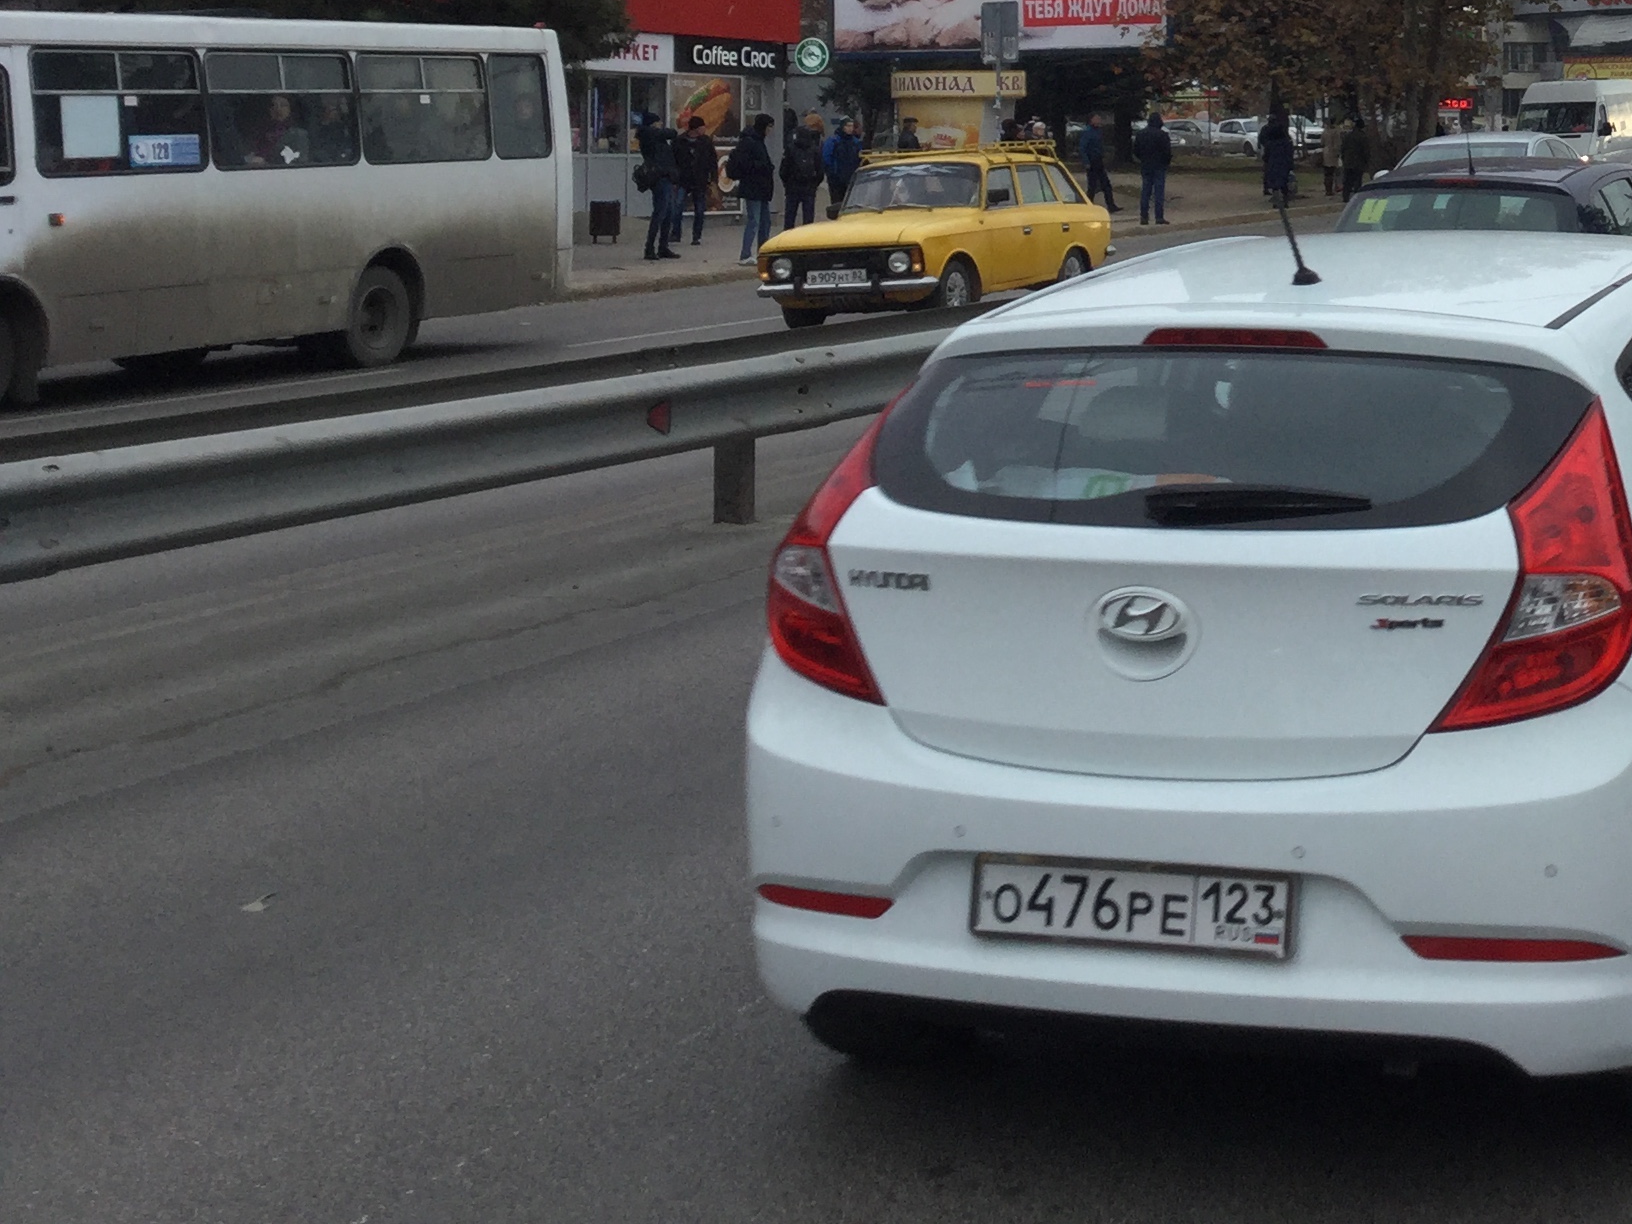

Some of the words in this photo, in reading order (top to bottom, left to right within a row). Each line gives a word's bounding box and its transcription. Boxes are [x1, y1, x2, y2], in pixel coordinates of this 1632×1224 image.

[1025, 0, 1064, 18] ТЕБЯ
[693, 44, 738, 66] Coffee
[1355, 594, 1484, 607] SOLARIS
[1201, 880, 1275, 926] 123
